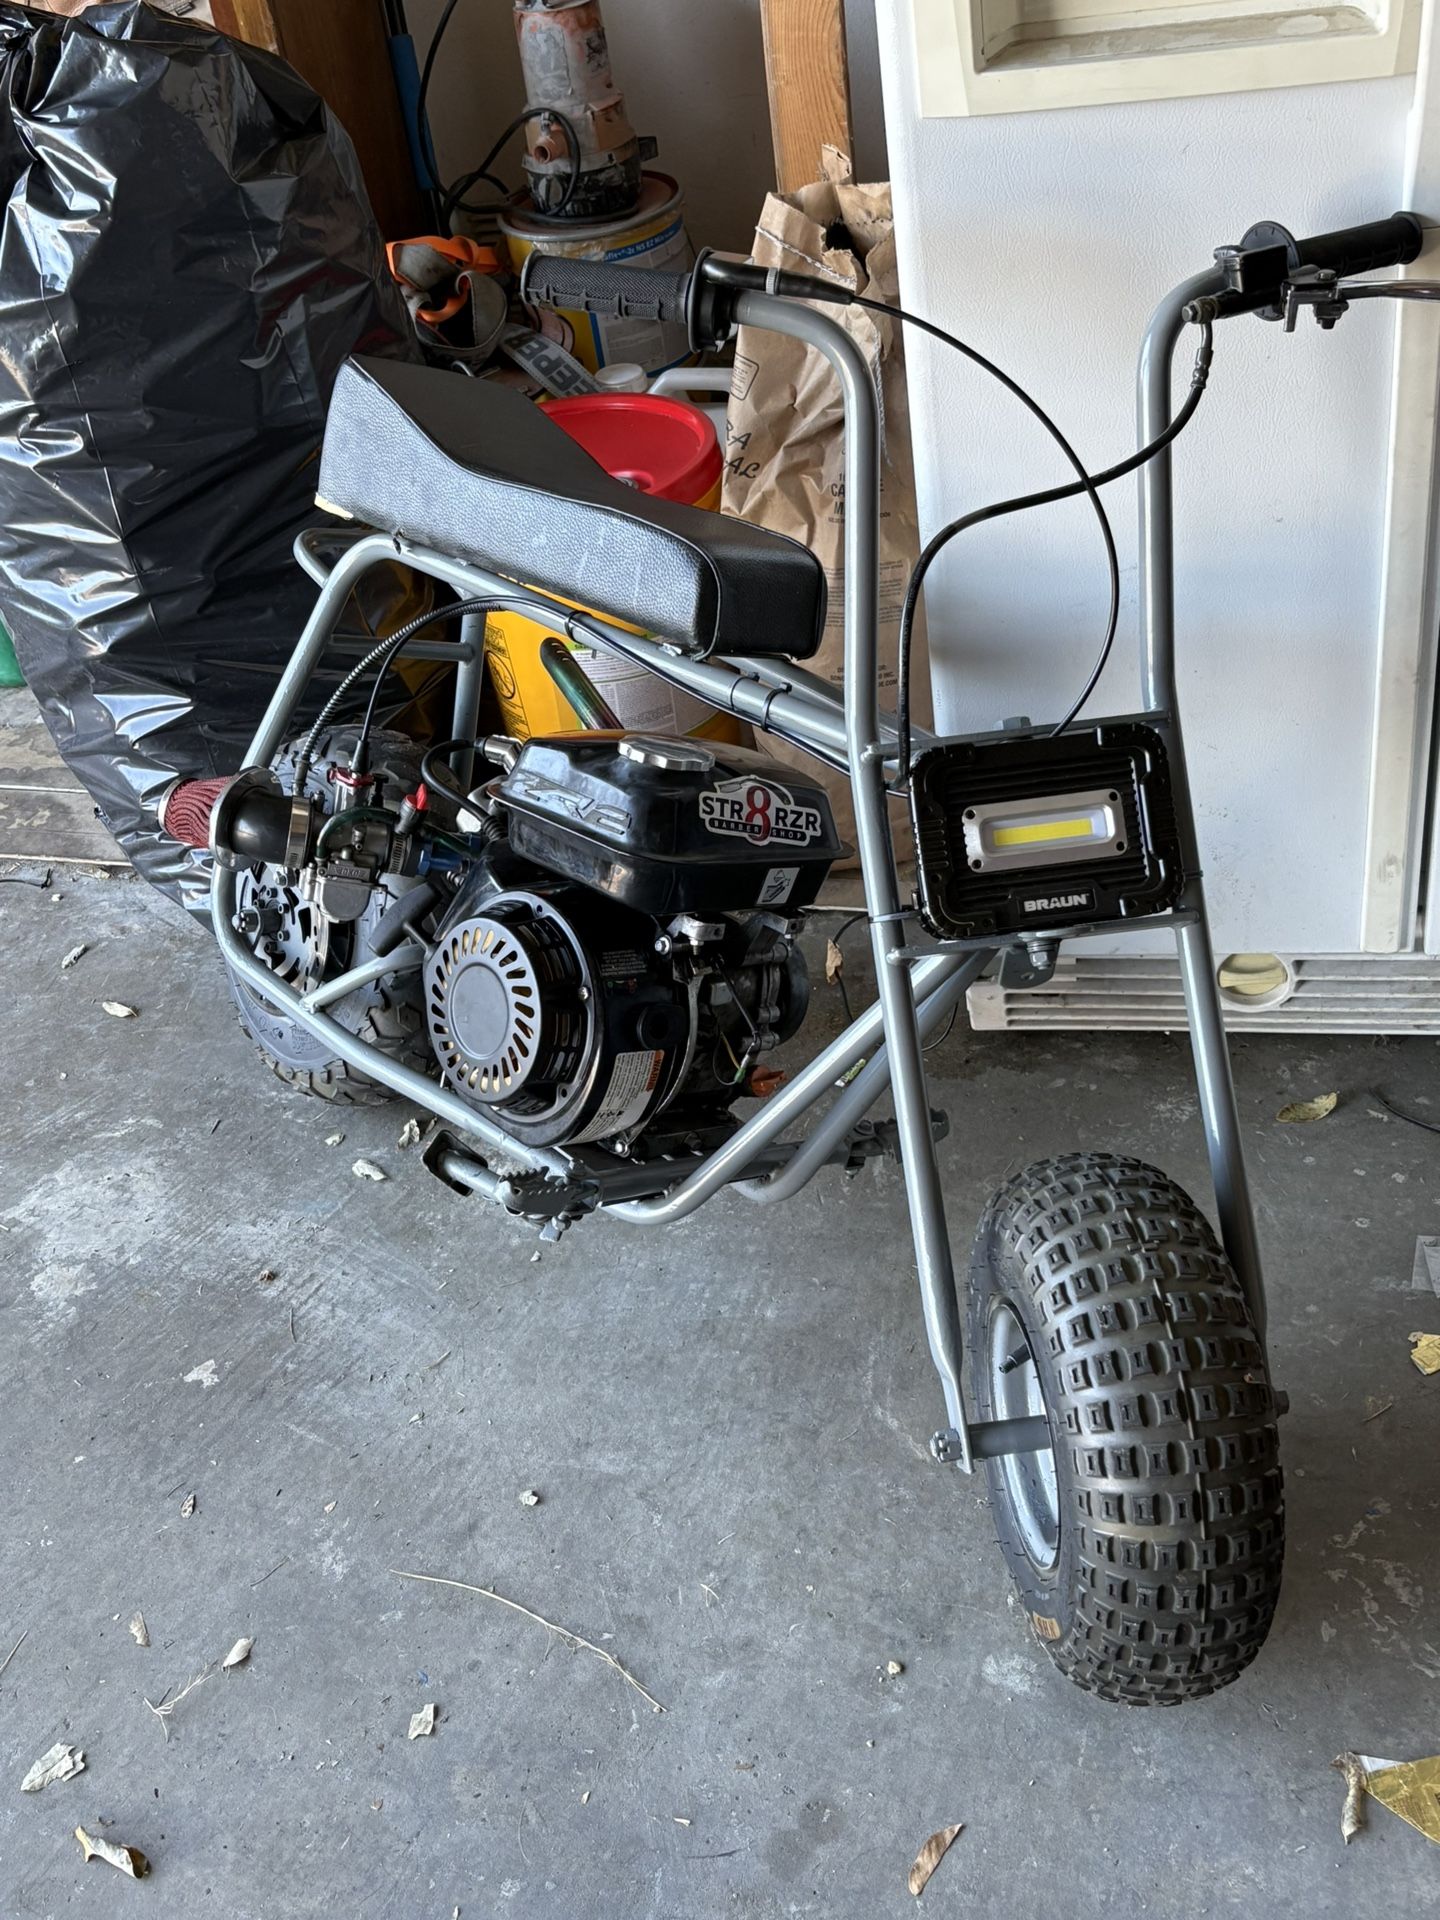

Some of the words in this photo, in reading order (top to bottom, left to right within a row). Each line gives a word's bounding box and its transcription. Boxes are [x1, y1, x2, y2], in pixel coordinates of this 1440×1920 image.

[774, 806, 818, 833] RZR
[713, 820, 759, 834] BARBER
[772, 829, 802, 840] SHOP
[1023, 893, 1087, 913] BRAUN
